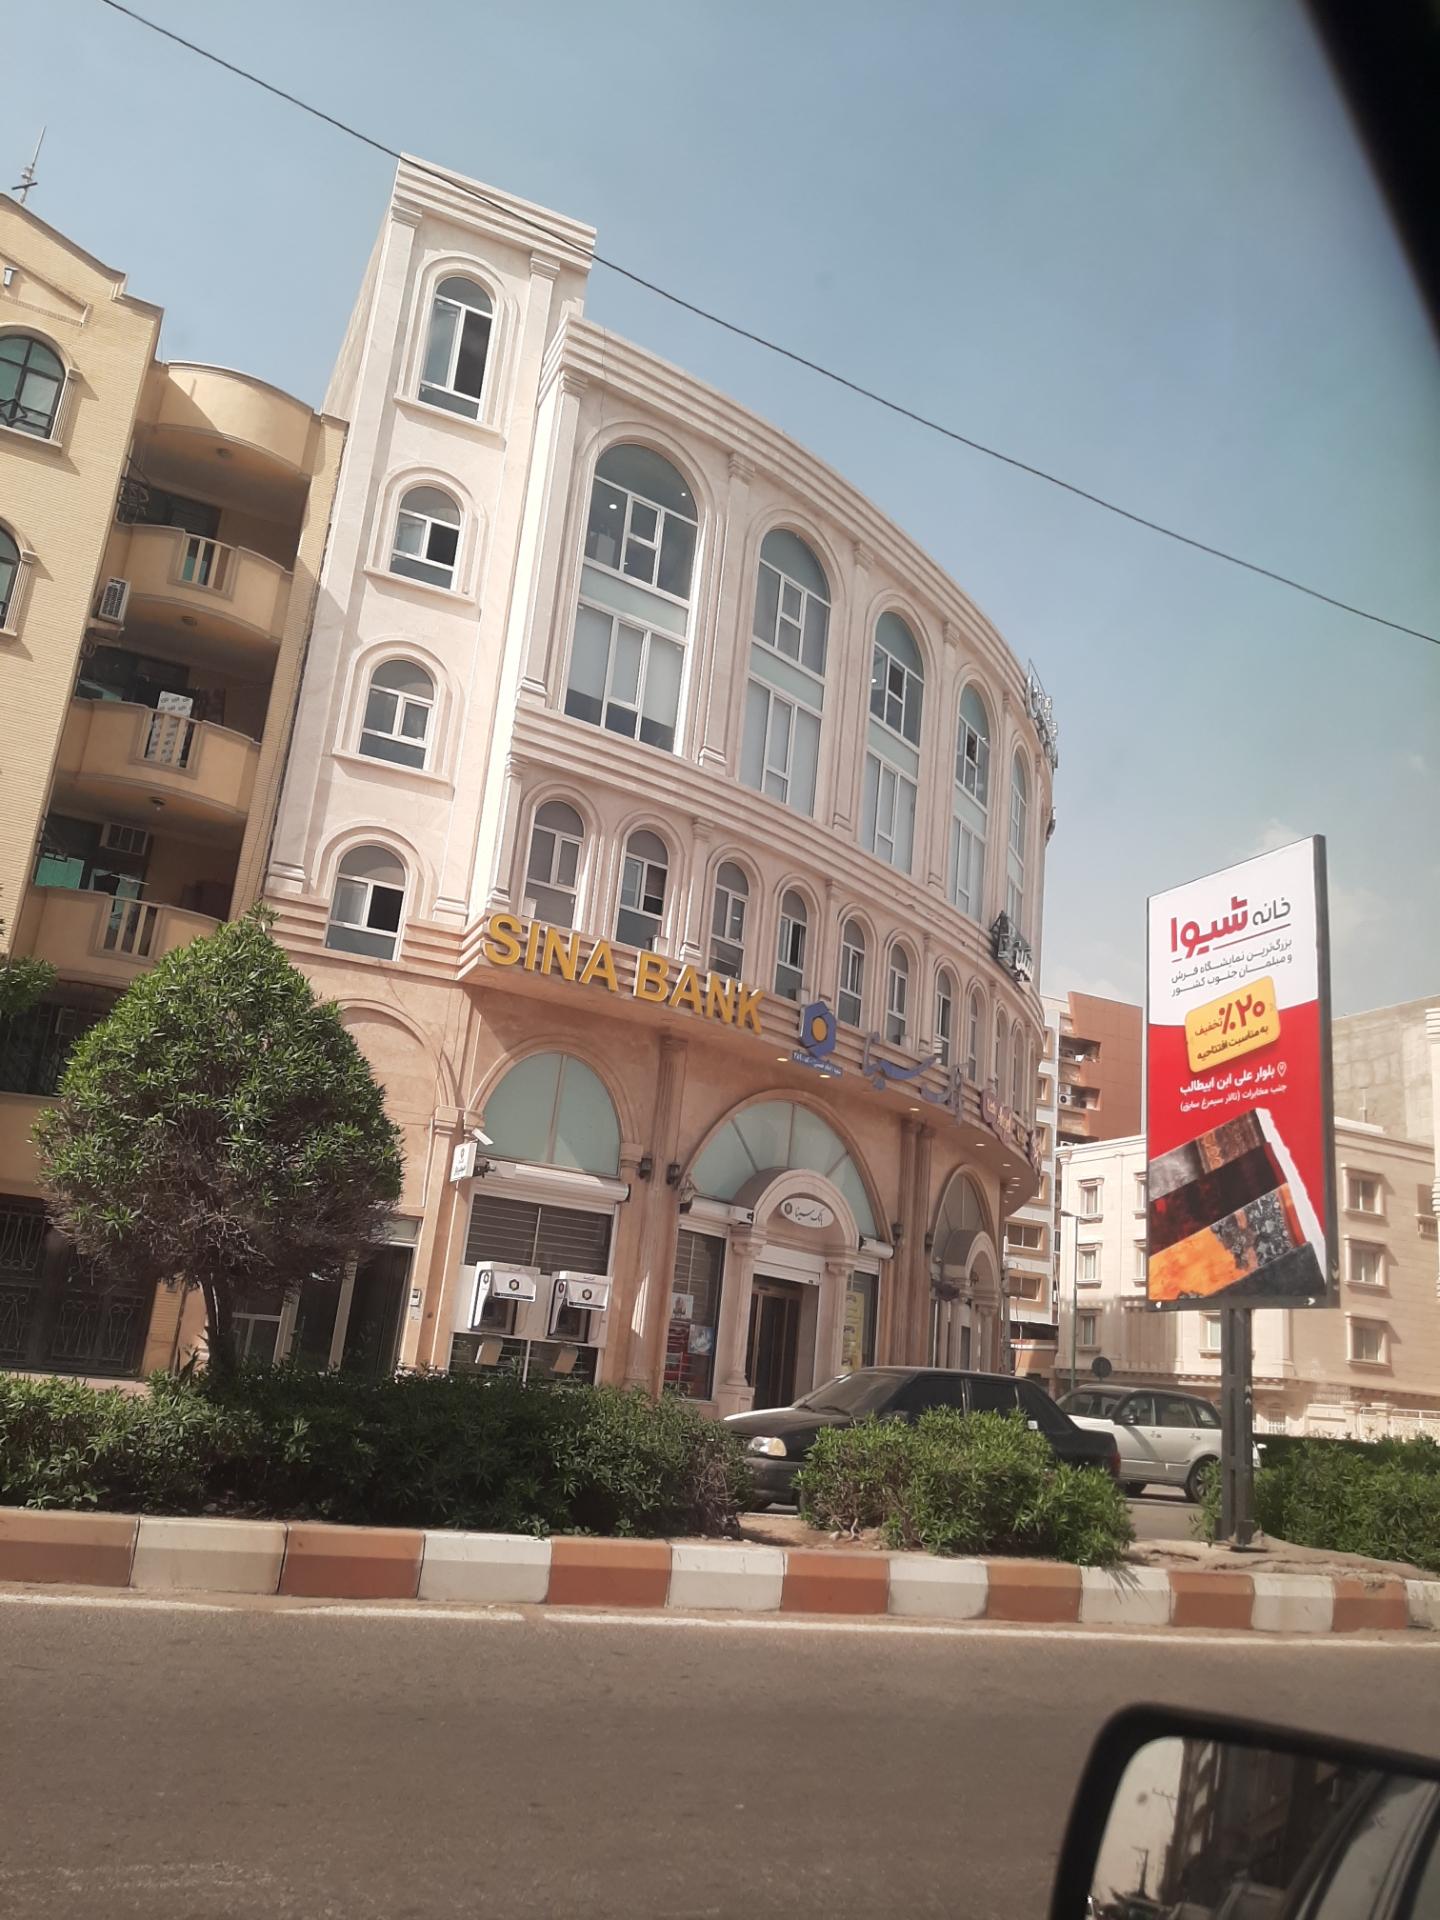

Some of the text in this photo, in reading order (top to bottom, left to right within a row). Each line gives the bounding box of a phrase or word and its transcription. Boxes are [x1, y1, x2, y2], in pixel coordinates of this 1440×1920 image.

[1171, 896, 1291, 959] خانه شیوا
[1200, 952, 1245, 974] نمایشگاه
[1239, 956, 1286, 978] مبلمان
[483, 913, 766, 1035] SINA BANK
[1171, 966, 1199, 984] فرش
[1207, 968, 1238, 985] جنوب
[1171, 976, 1206, 997] کشور
[1194, 1016, 1223, 1036] تخفیف
[1197, 1025, 1269, 1061] به مناسبت افتتاحیه
[1179, 1064, 1276, 1096] بلوار علی ابن ابیطالب
[1270, 1084, 1287, 1094] جنب
[1201, 1097, 1224, 1110] سیمرغ
[1242, 1088, 1269, 1100] مخابرات
[794, 1206, 815, 1221] سینا
